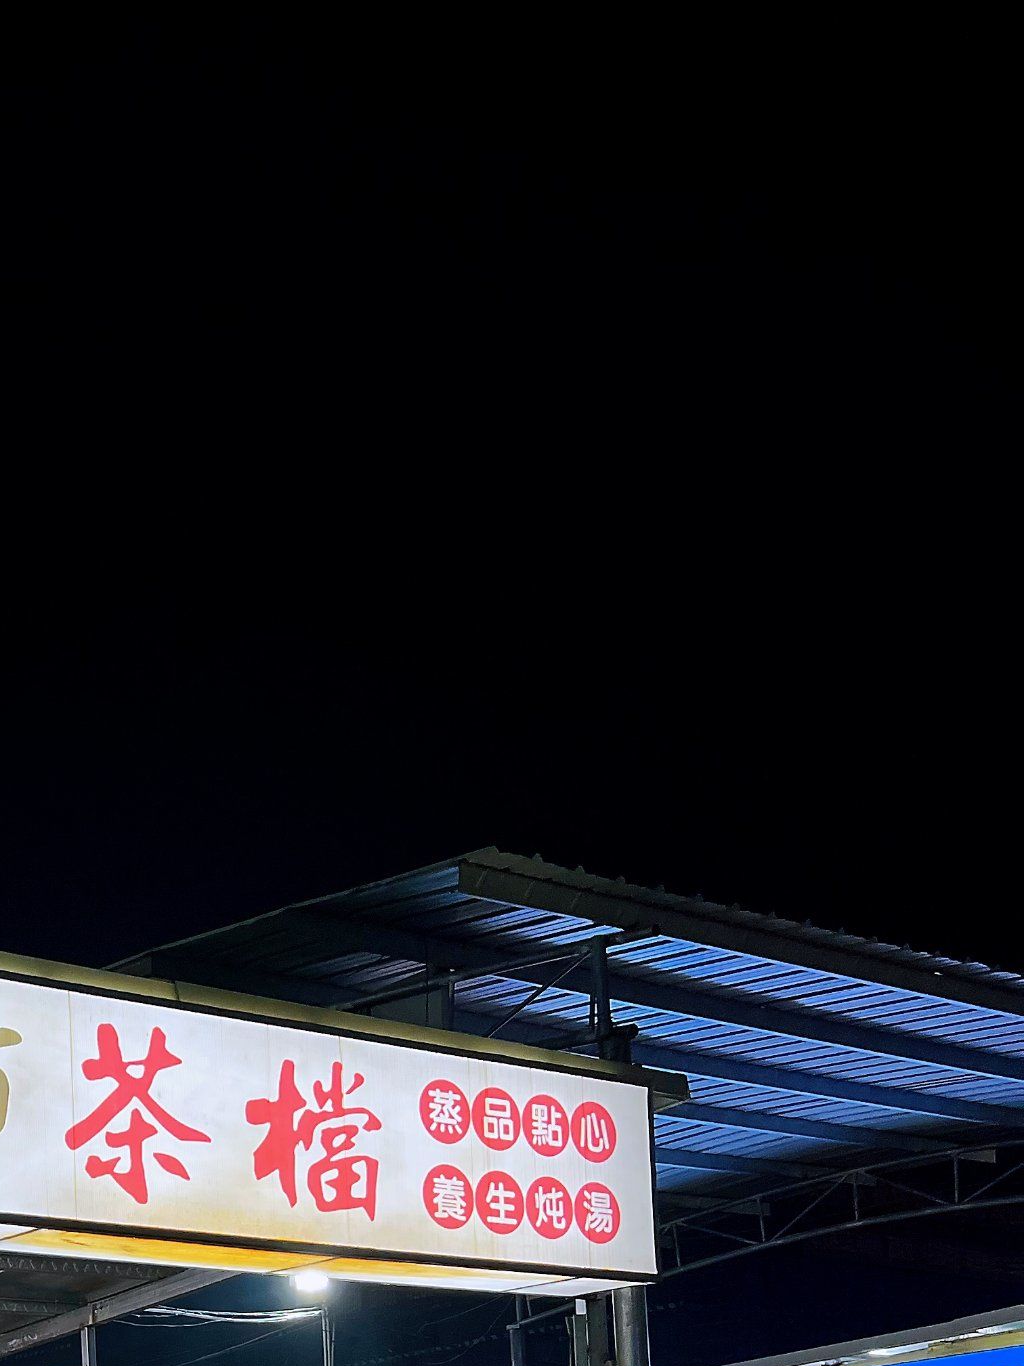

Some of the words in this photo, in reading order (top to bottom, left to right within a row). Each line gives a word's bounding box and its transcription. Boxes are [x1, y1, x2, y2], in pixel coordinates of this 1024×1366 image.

[427, 1087, 610, 1154] 蒸品點心
[432, 1174, 614, 1234] 養生炖湯
